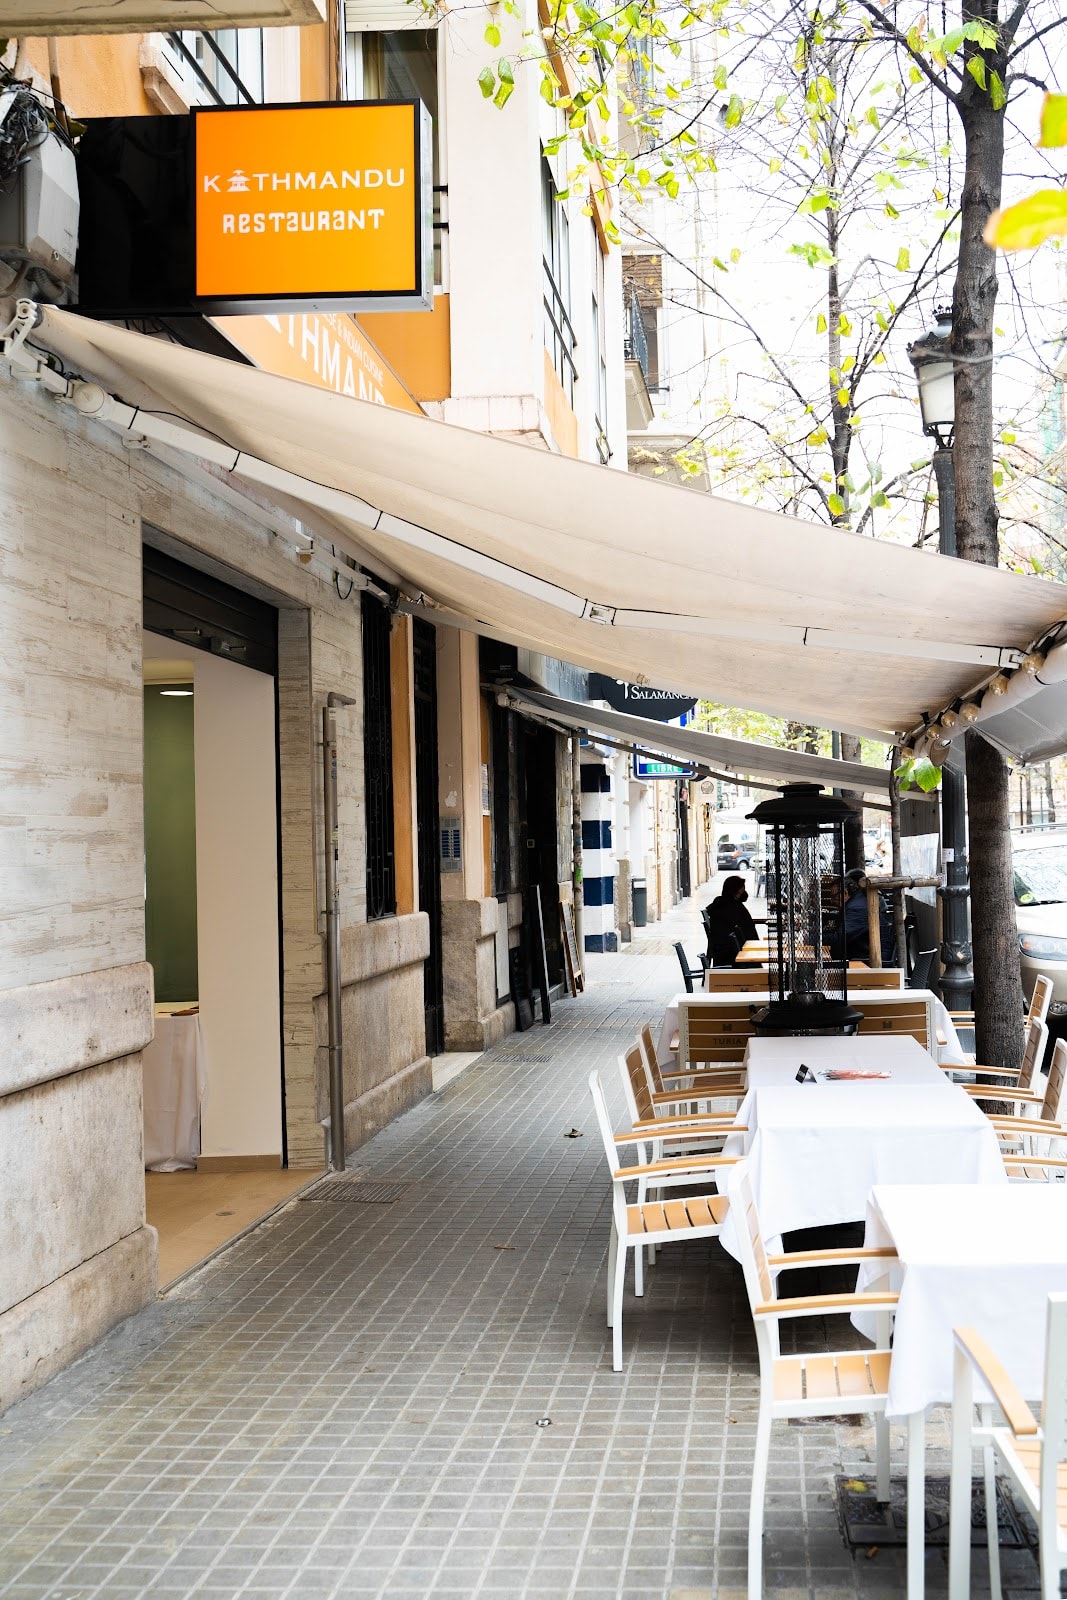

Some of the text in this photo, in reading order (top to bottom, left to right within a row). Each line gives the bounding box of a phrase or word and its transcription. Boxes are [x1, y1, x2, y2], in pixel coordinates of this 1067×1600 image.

[363, 351, 384, 388] CUISINE
[651, 763, 679, 773] LIBRE
[713, 1037, 742, 1046] TURIA
